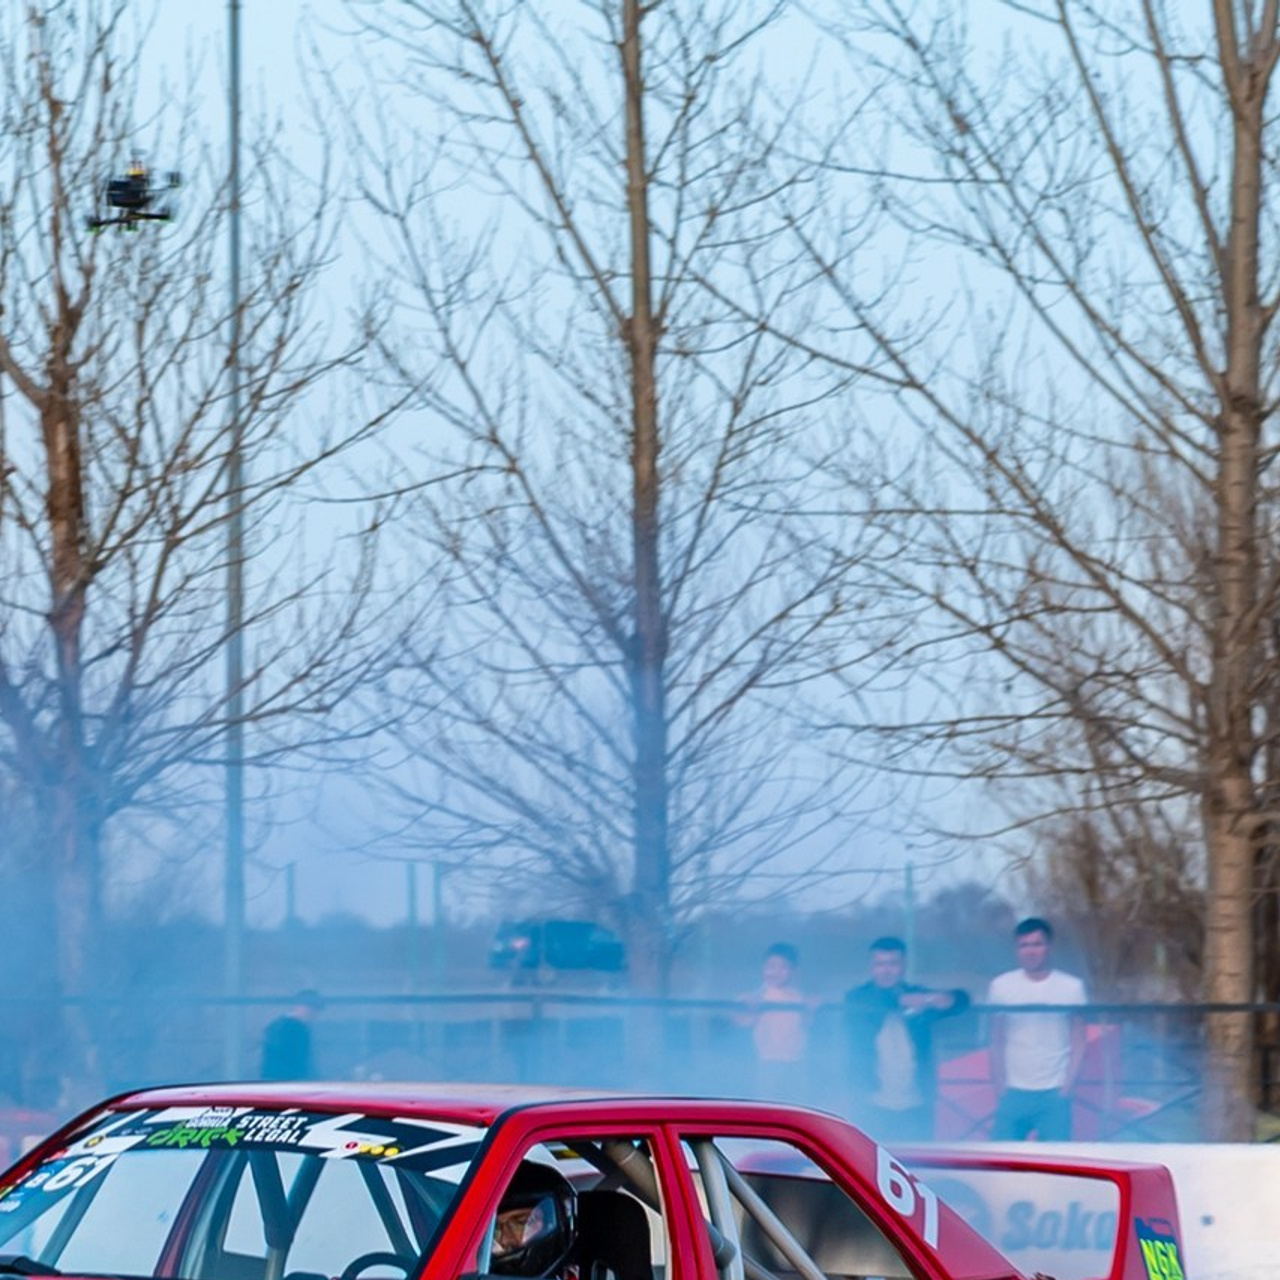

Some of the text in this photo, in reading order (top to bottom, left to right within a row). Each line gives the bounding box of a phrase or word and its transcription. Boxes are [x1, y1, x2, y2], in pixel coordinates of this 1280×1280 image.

[236, 1115, 308, 1130] STREET
[243, 1128, 301, 1144] LEGAL
[43, 1153, 120, 1193] 61
[877, 1146, 939, 1250] 61
